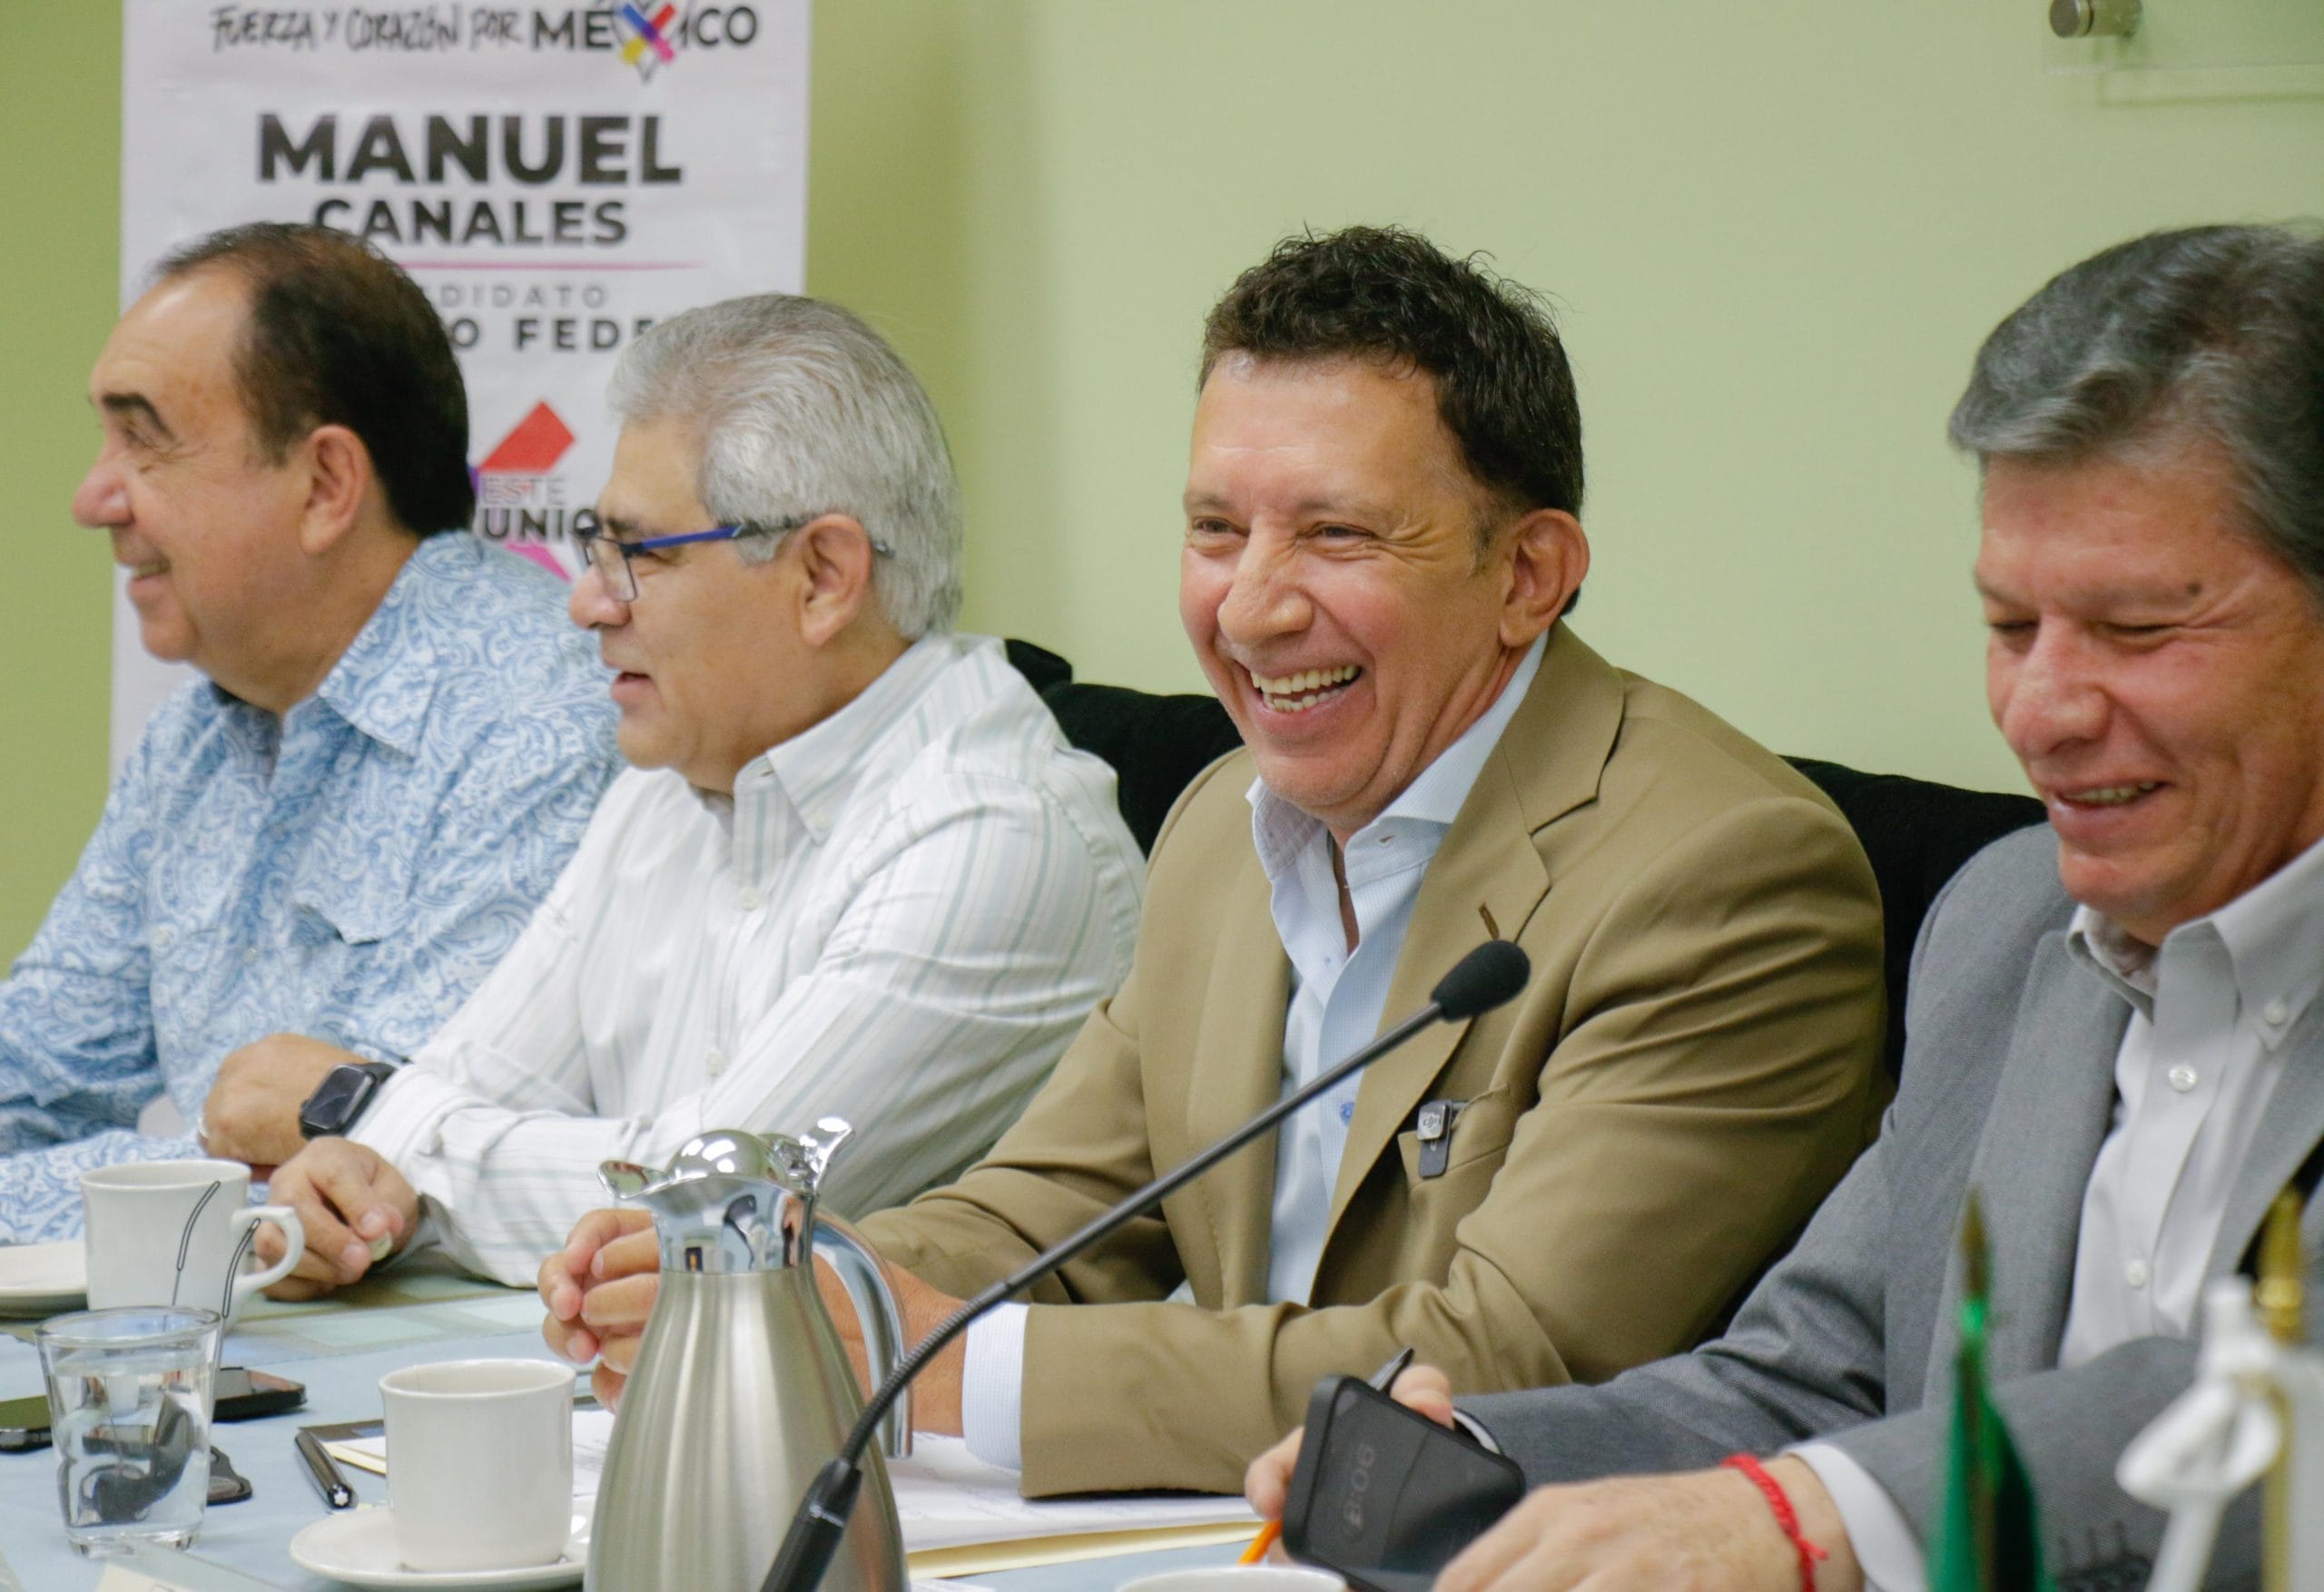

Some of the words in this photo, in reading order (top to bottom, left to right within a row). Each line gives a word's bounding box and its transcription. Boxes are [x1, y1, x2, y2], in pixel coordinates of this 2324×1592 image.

[212, 5, 319, 53] FUERZA
[323, 10, 340, 42] Y
[469, 8, 524, 51] POR
[259, 113, 683, 183] MANUEL
[315, 199, 627, 246] CANALES
[421, 285, 608, 309] DIDATO
[483, 477, 566, 506] ESTE
